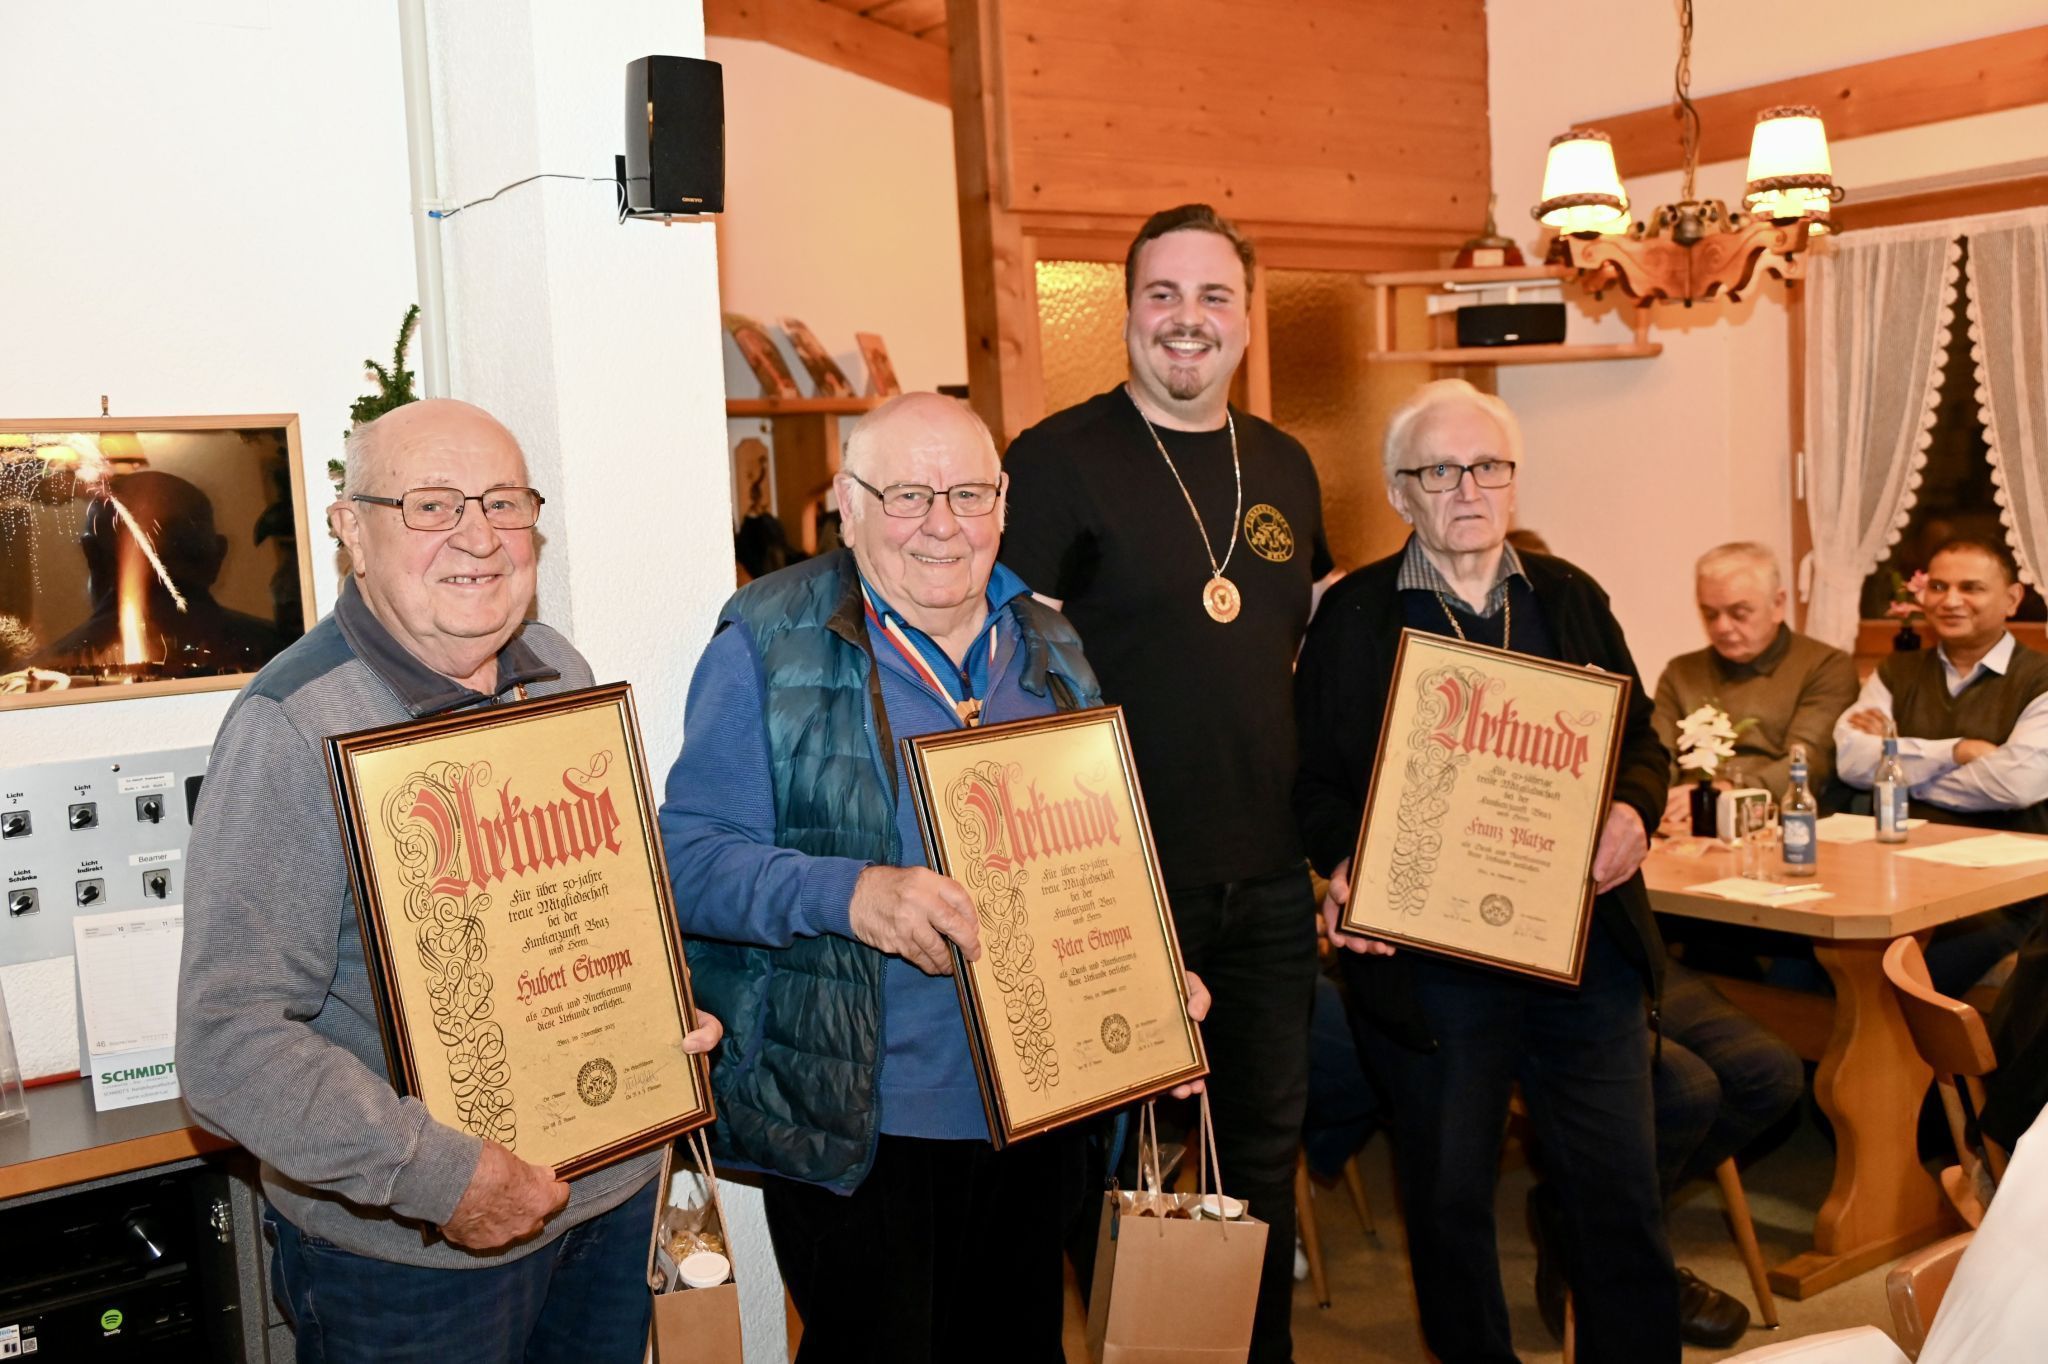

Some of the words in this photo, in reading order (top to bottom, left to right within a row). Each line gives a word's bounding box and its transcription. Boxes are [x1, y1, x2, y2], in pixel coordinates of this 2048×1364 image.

[1427, 676, 1600, 779] Urkunde
[407, 750, 623, 897] Urkunde
[964, 761, 1121, 872] Urkunde
[77, 865, 103, 873] Indirekt
[138, 854, 168, 863] Beamer
[508, 907, 533, 922] treue
[537, 883, 609, 914] Mitgliedschaft
[510, 889, 531, 907] Für
[536, 882, 557, 897] über
[522, 924, 581, 953] Funkenzunft
[585, 917, 610, 931] Braz
[547, 915, 560, 927] bei
[564, 911, 578, 923] der
[1052, 938, 1084, 966] Peter
[1088, 927, 1132, 950] Stroppa
[517, 964, 567, 1005] Hubert
[572, 948, 633, 982] Stroppa
[525, 1011, 538, 1023] als
[541, 1004, 564, 1018] Dank
[567, 997, 581, 1009] und
[101, 1062, 176, 1084] SCHMIDT
